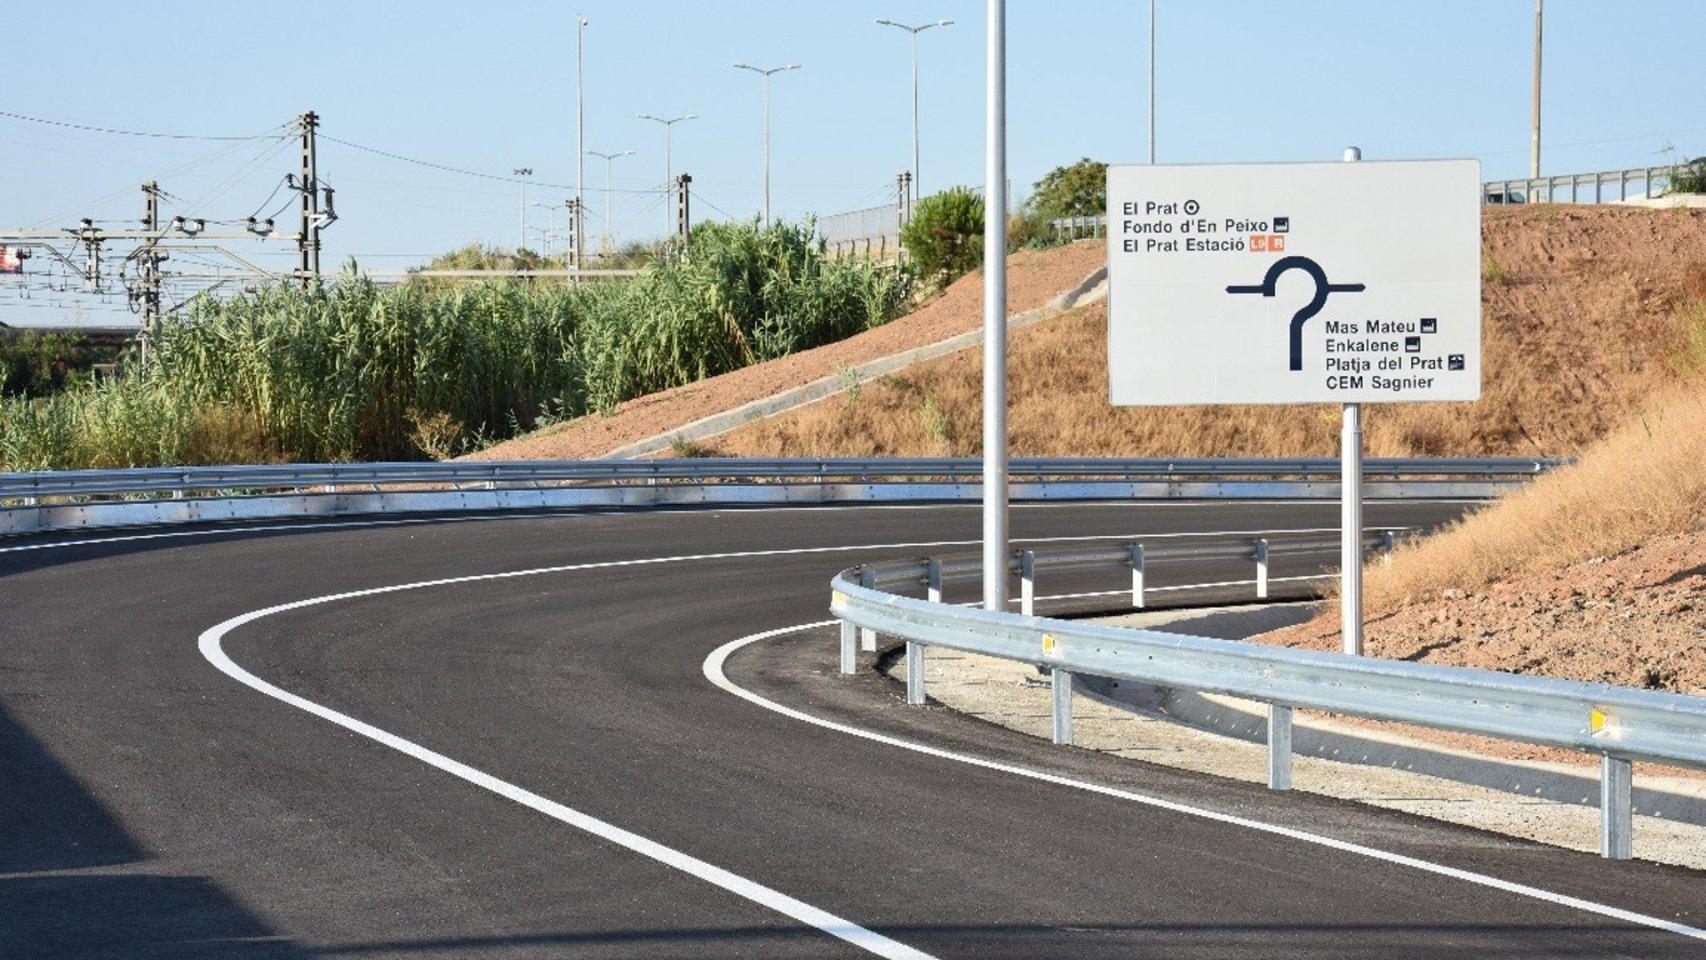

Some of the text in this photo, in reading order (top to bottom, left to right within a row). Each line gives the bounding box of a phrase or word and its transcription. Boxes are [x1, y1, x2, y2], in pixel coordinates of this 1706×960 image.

[1124, 201, 1178, 215] El Prat
[1123, 218, 1268, 234] Fondo d'En Peixo
[1123, 239, 1138, 252] El
[1147, 239, 1178, 252] Prat
[1186, 237, 1245, 252] Estació
[1326, 319, 1415, 334] Mas Mateu
[1326, 338, 1399, 352] Enkalene
[1326, 356, 1443, 374] Platja del Prat
[1326, 375, 1434, 392] CEM Sagnier
